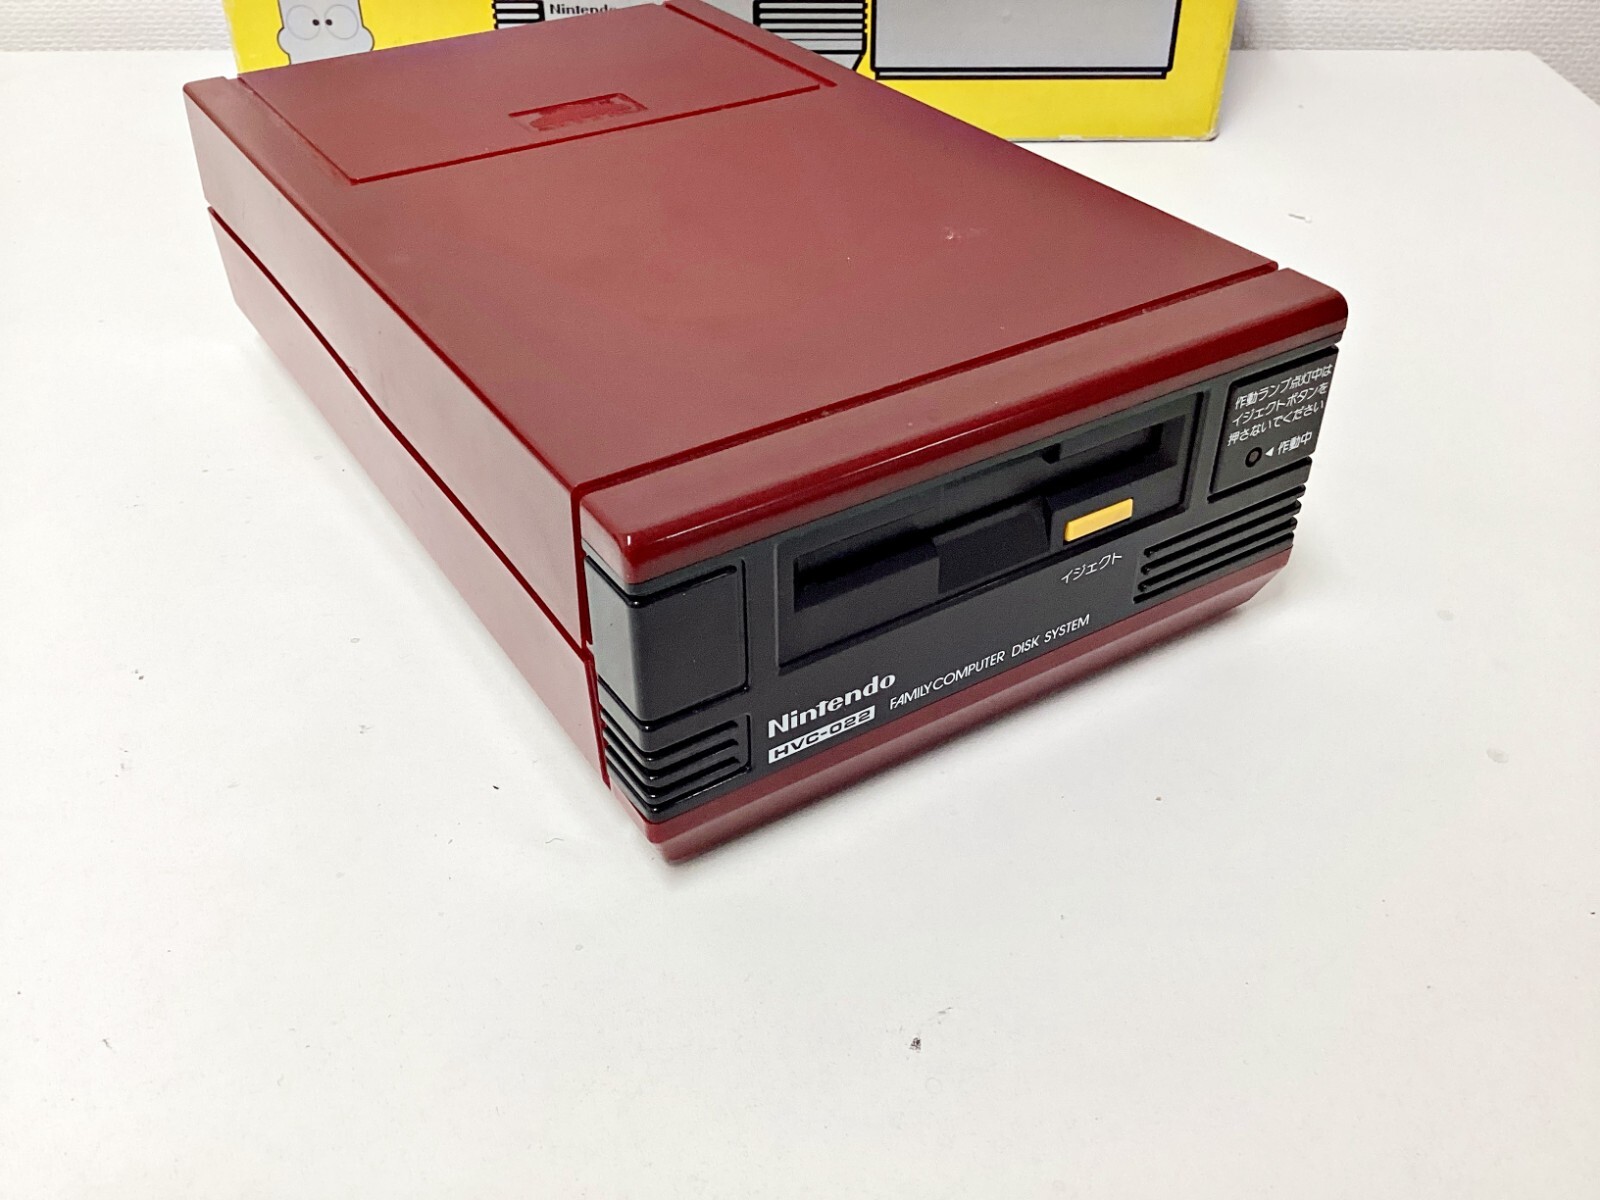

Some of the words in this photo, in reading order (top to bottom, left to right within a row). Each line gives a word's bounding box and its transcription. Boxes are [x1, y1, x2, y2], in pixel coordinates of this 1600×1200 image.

[1232, 382, 1328, 427] イジェクトボタンを
[1235, 364, 1333, 410] 作動ランプ点灯中は
[1227, 400, 1324, 447] 押さないでください
[1278, 431, 1313, 455] 作動中
[1061, 552, 1123, 584] イジェクト
[1011, 635, 1042, 657] DISK
[1044, 614, 1090, 643] SYSTEM
[768, 674, 896, 738] Nintendo
[774, 710, 871, 758] HVC-022
